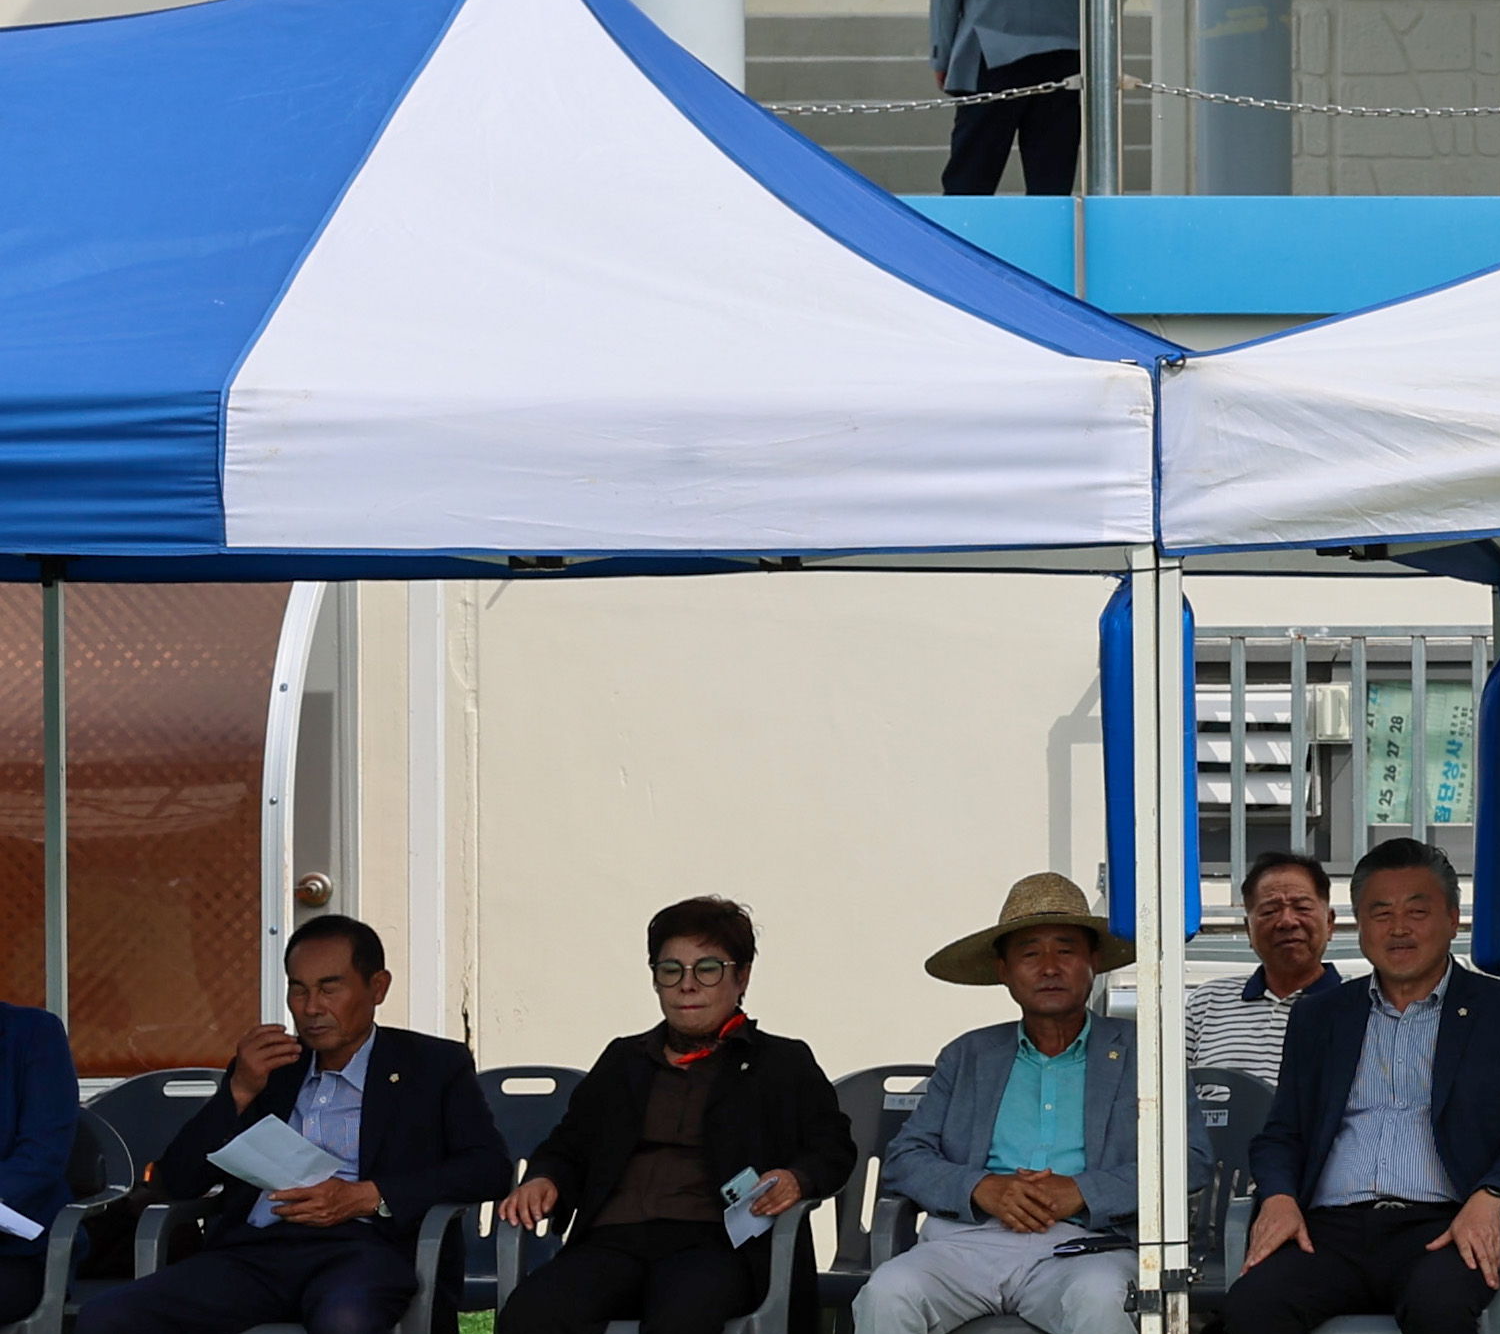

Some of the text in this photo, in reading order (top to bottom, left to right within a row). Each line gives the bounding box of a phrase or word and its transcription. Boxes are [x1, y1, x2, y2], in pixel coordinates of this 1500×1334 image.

[1389, 715, 1405, 734] 28
[1386, 739, 1401, 759] 27
[1383, 764, 1397, 783] 26
[1378, 788, 1394, 807] 25
